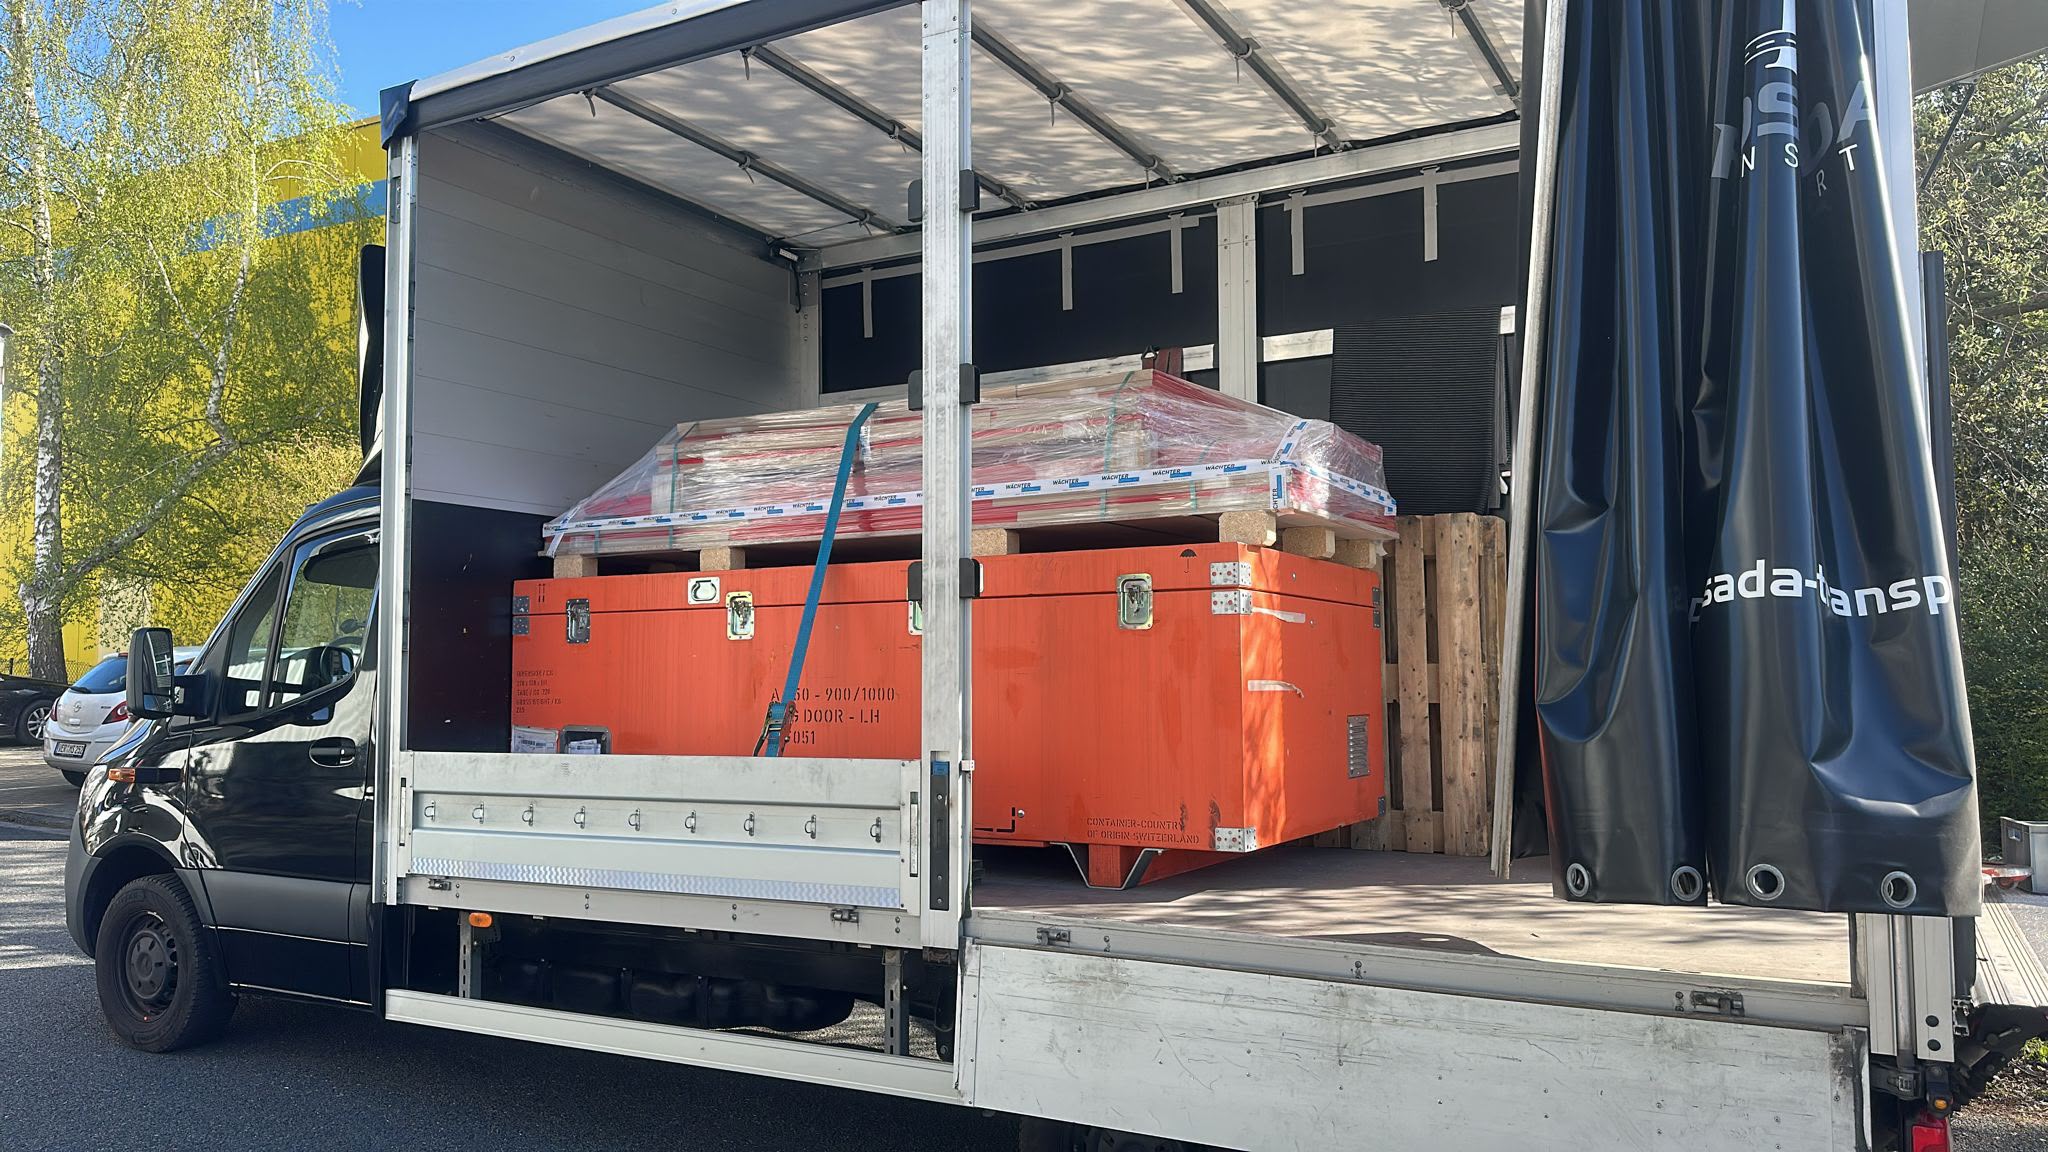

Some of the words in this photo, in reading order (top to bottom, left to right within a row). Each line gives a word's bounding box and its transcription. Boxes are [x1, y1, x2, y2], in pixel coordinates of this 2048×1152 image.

[770, 687, 810, 701] A50
[825, 686, 896, 701] 900/1000
[803, 709, 844, 723] DOOR
[860, 709, 880, 723] LH
